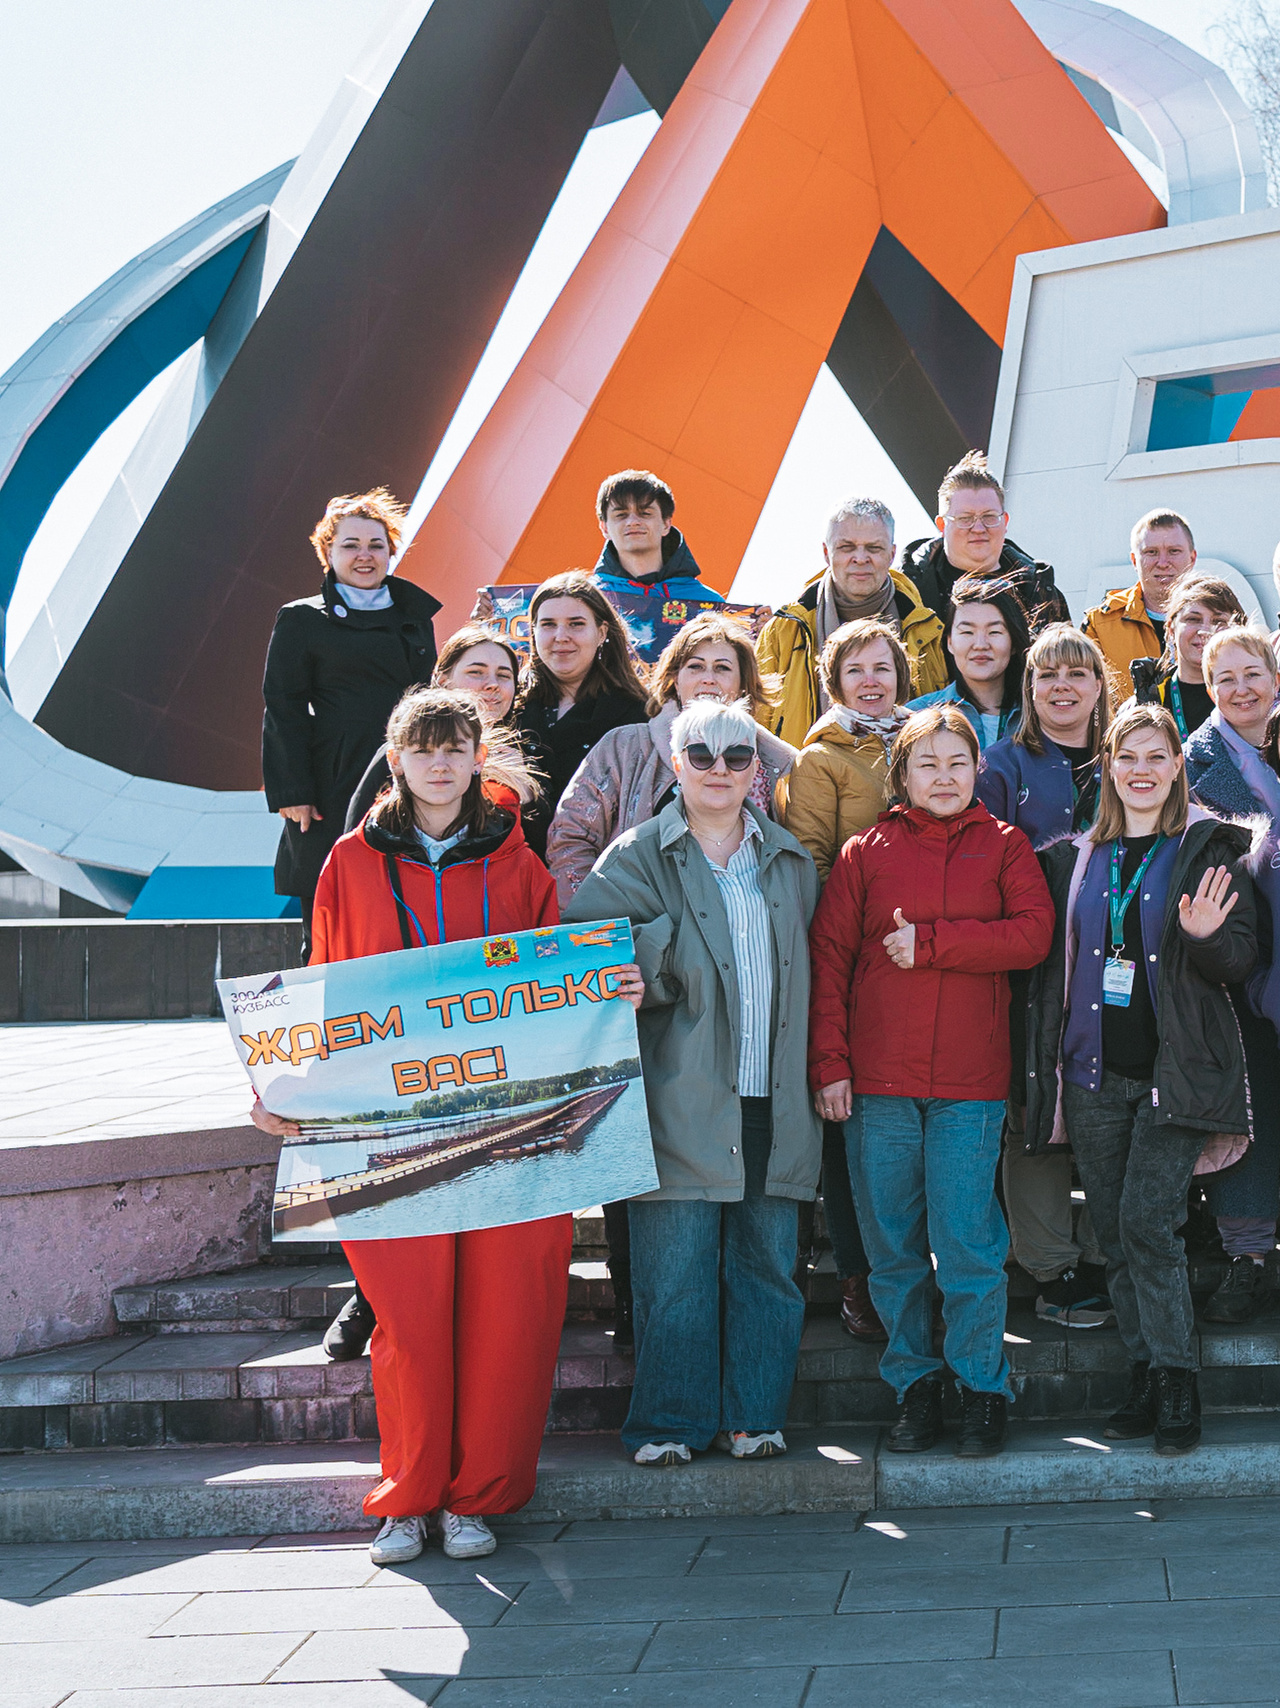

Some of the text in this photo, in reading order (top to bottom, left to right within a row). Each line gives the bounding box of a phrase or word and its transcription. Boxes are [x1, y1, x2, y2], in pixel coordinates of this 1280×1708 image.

[232, 994, 290, 1015] КУЗБАСС
[239, 1005, 405, 1067] ЖДЕМ
[391, 1046, 509, 1096] ВАС!
